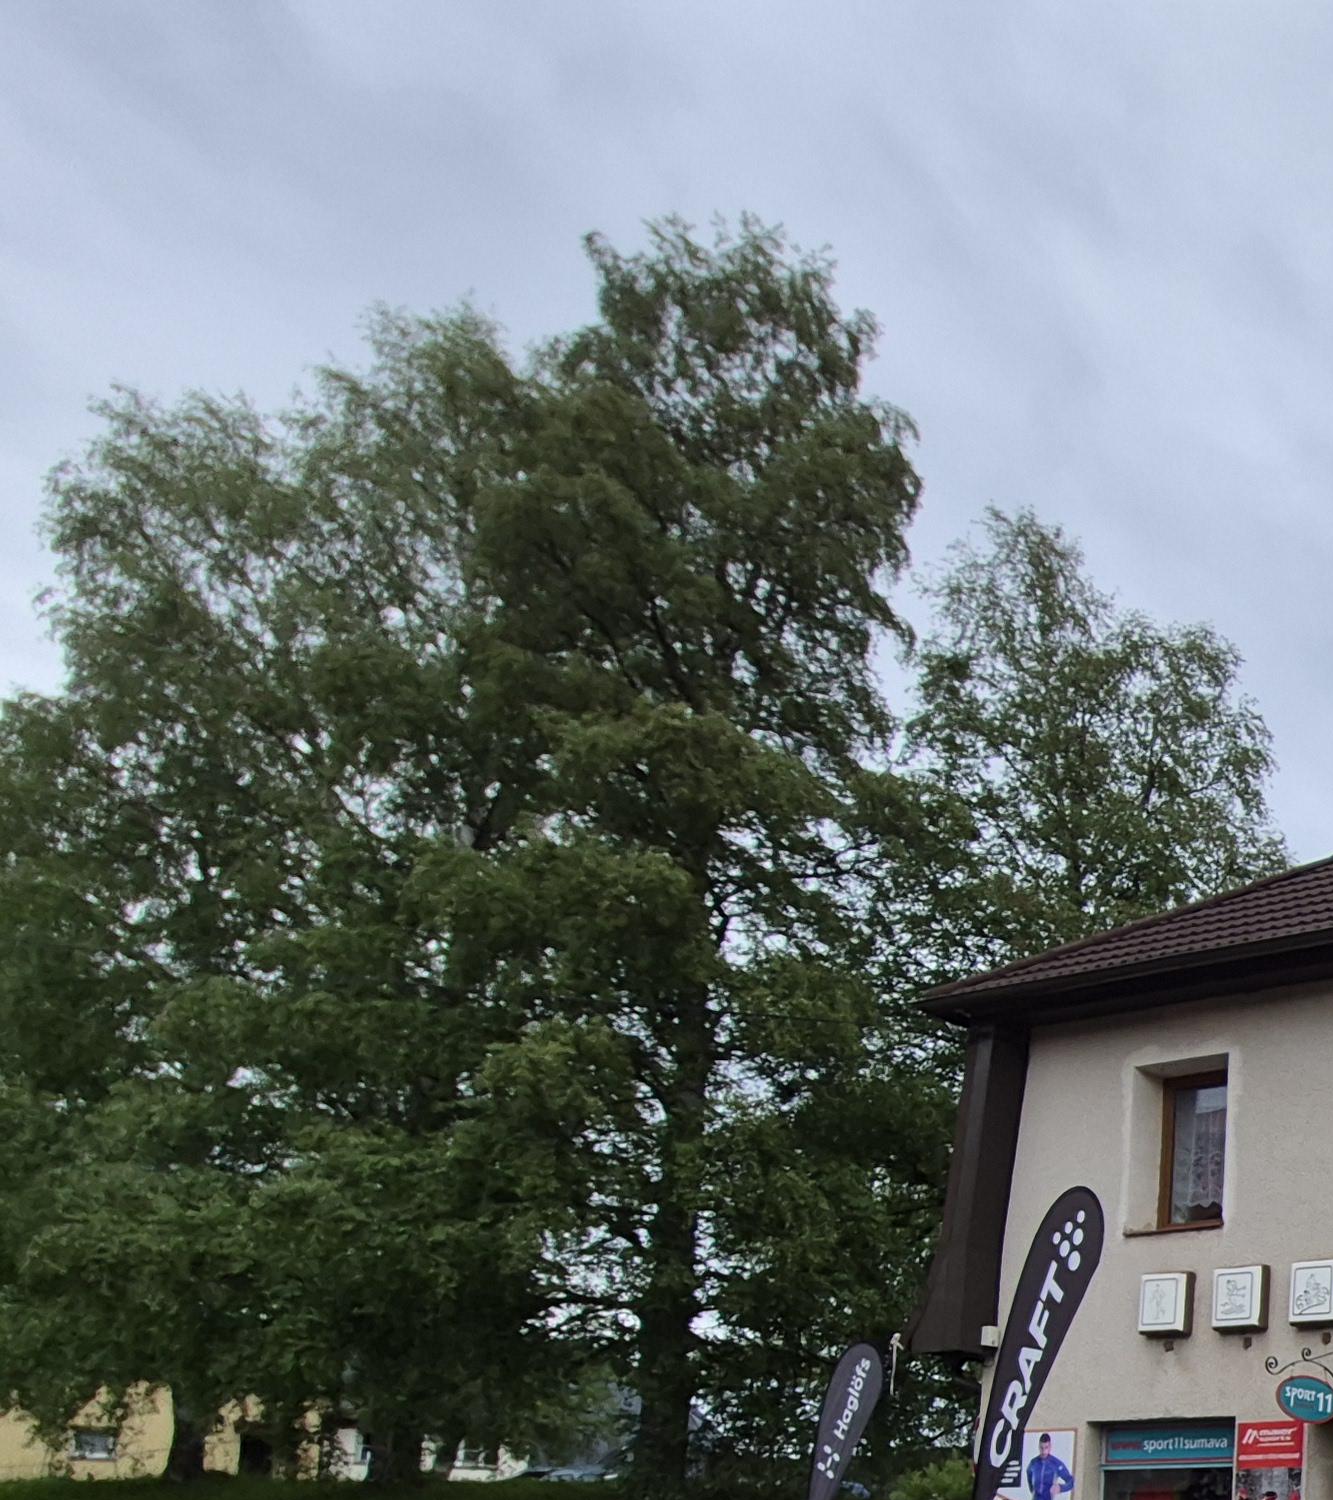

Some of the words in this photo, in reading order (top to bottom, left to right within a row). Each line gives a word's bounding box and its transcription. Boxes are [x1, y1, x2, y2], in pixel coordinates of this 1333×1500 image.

[833, 1357, 871, 1440] Haglöfs
[989, 1259, 1064, 1468] CRAFT
[1316, 1391, 1333, 1413] 11
